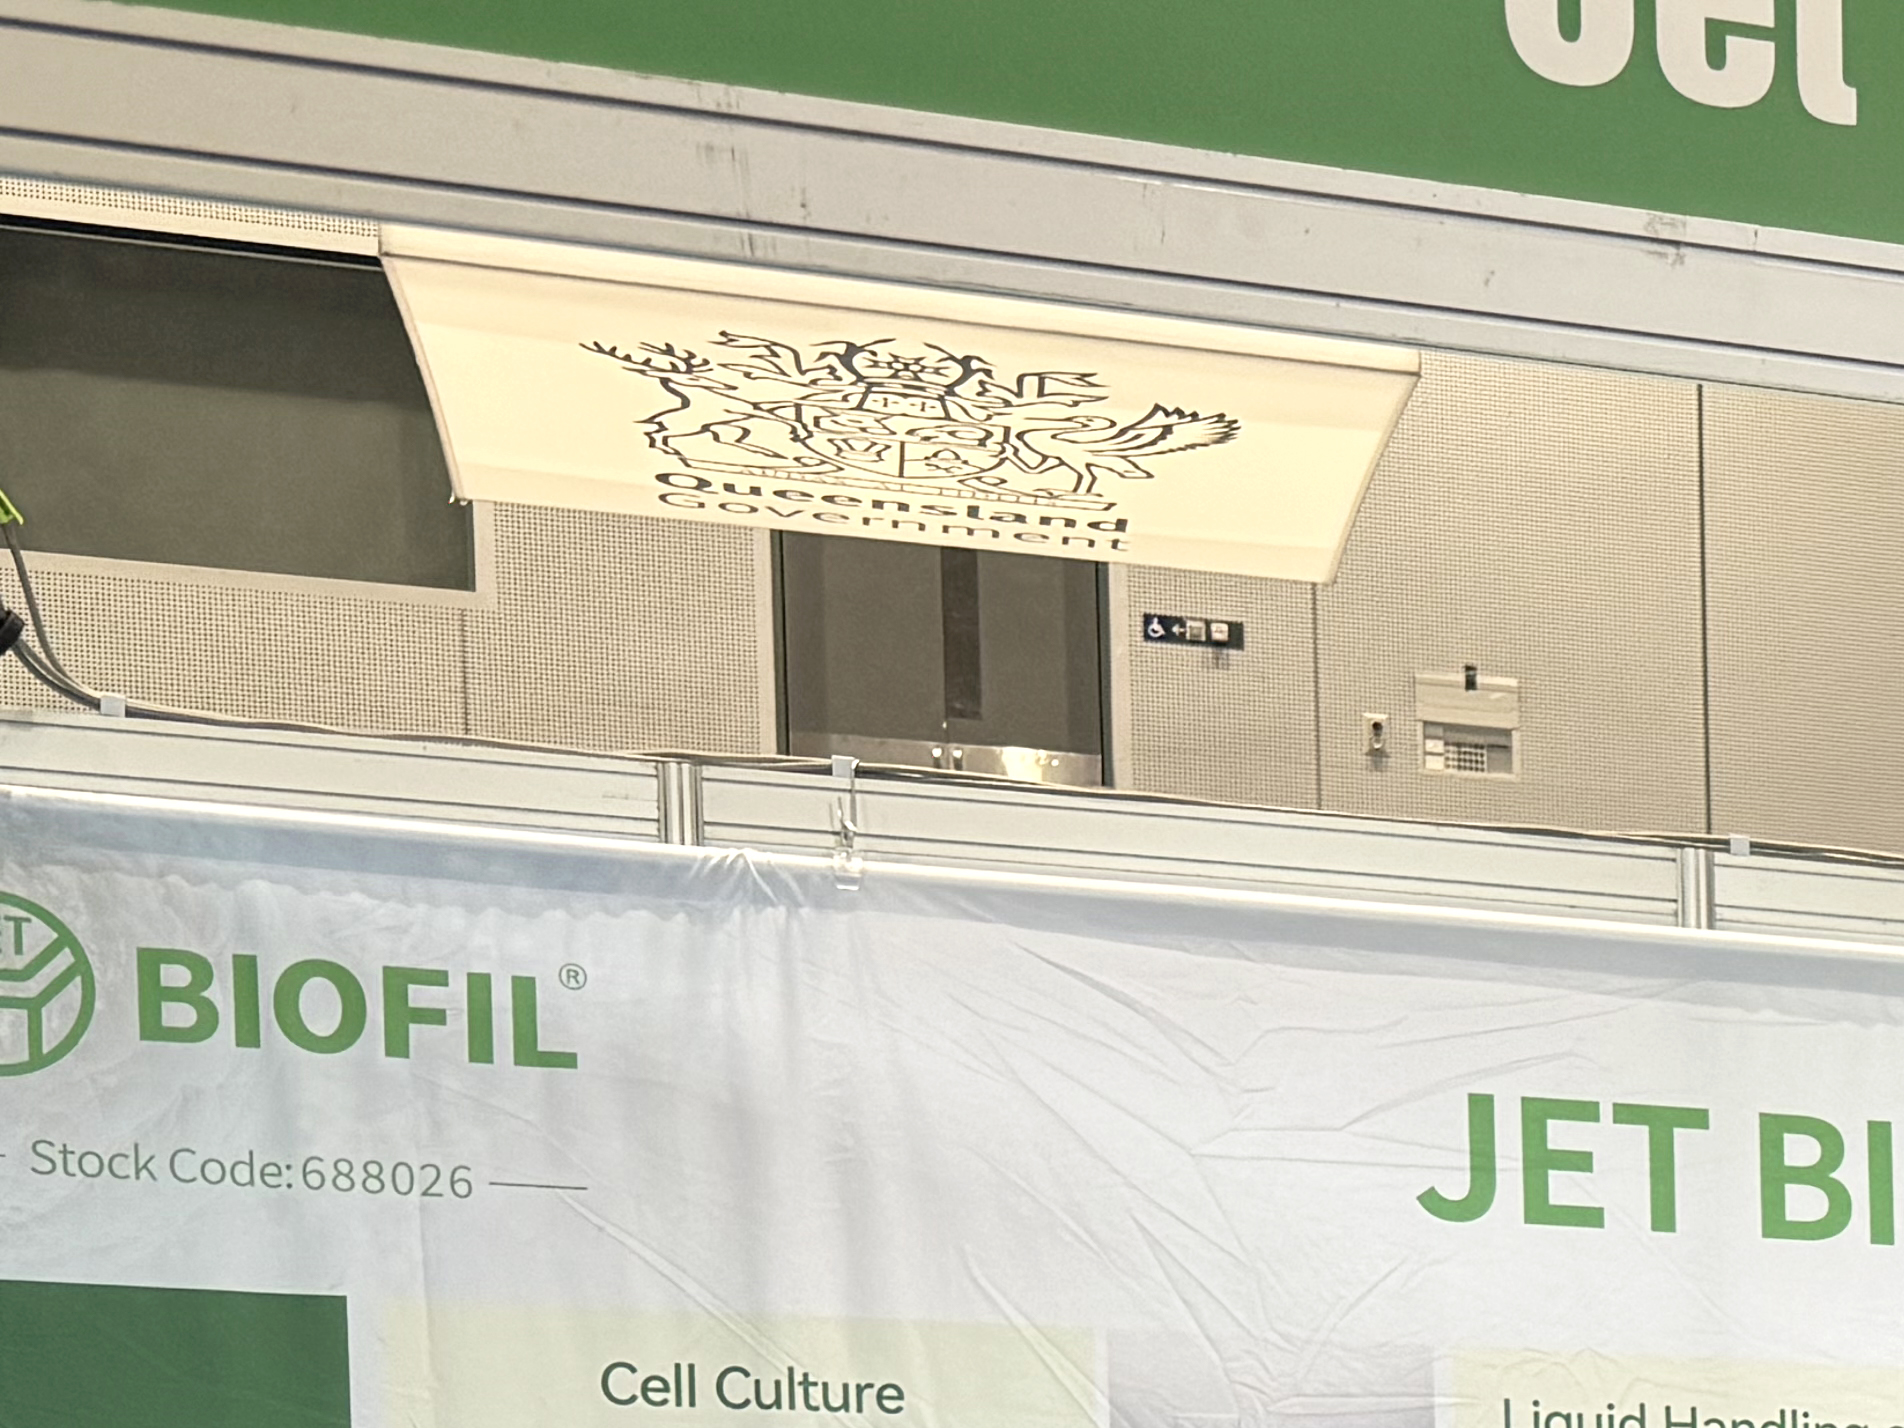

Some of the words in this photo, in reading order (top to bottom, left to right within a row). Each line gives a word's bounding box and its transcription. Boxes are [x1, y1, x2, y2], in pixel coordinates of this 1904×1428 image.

[654, 472, 1129, 534] Queensland
[657, 491, 1129, 552] Government
[29, 1137, 158, 1183] Stock
[1415, 1091, 1711, 1234] JET
[599, 1360, 696, 1409] Cell
[714, 1365, 907, 1416] Culture
